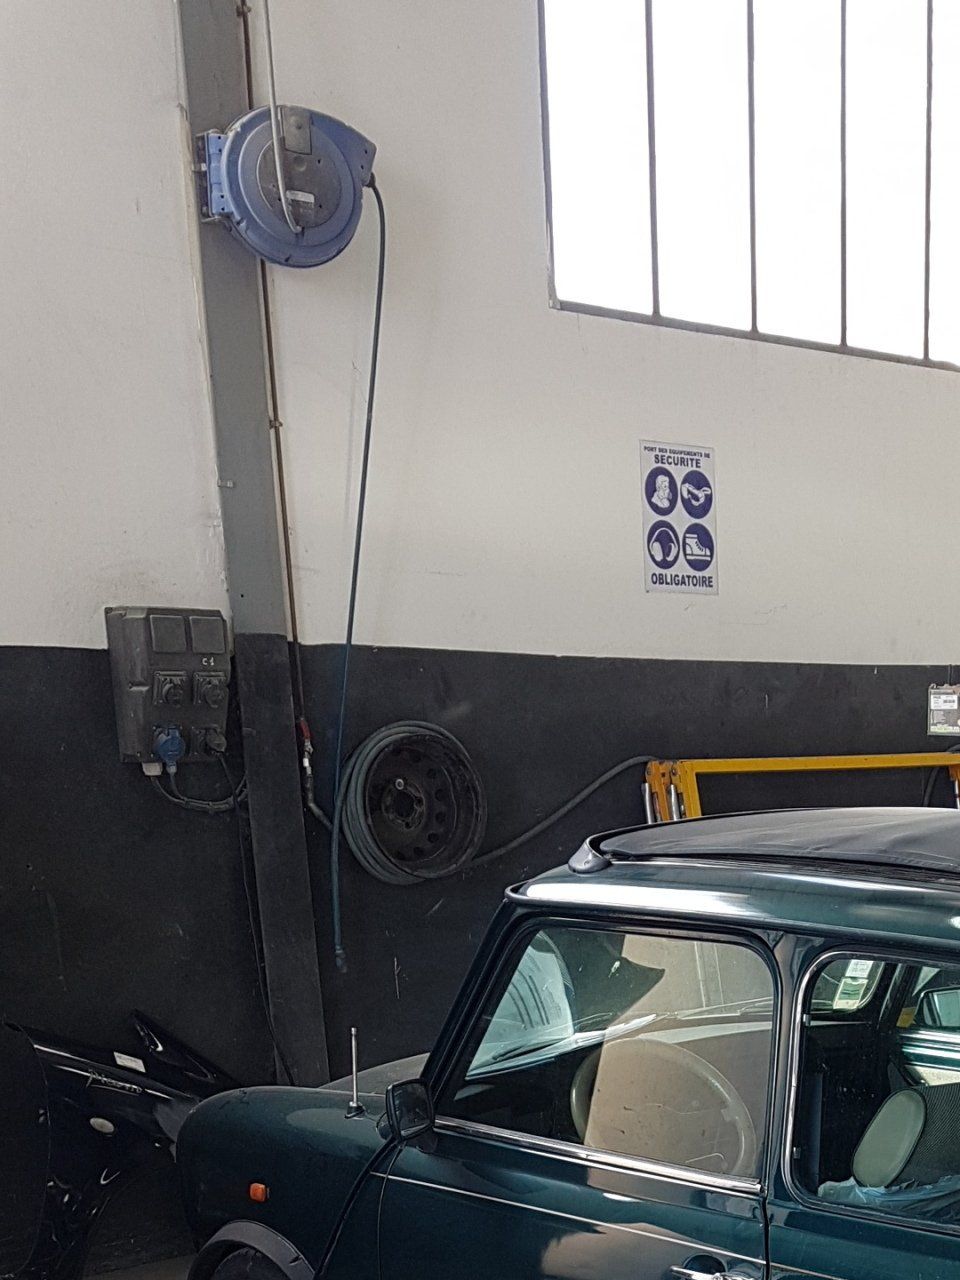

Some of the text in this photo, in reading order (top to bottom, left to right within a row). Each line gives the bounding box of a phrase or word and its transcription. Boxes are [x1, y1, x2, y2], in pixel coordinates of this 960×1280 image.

[669, 448, 703, 458] EQUIPEMENTS
[654, 454, 701, 468] SECURITE
[651, 572, 713, 588] OBLIGATOIRE
